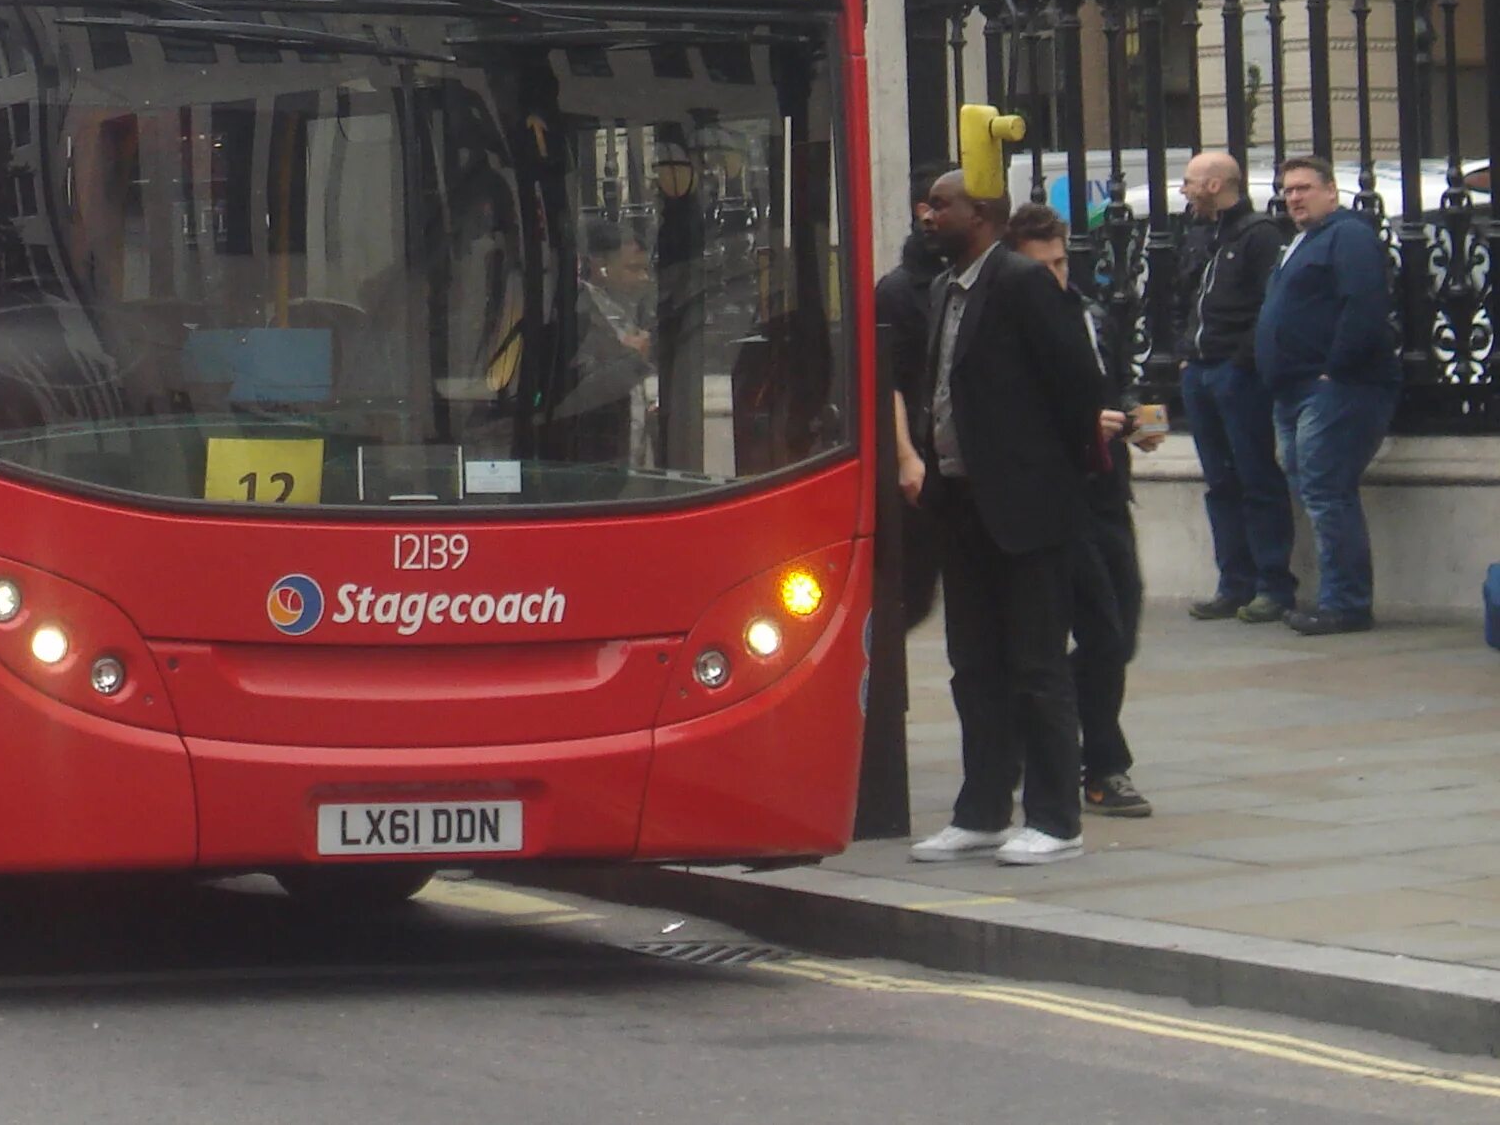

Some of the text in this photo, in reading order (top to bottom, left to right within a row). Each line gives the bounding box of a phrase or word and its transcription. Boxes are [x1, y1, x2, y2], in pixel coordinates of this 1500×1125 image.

[238, 471, 294, 504] 12
[393, 533, 470, 570] 12139
[331, 583, 567, 636] Stagecoach
[340, 807, 500, 846] LX61 DDN
